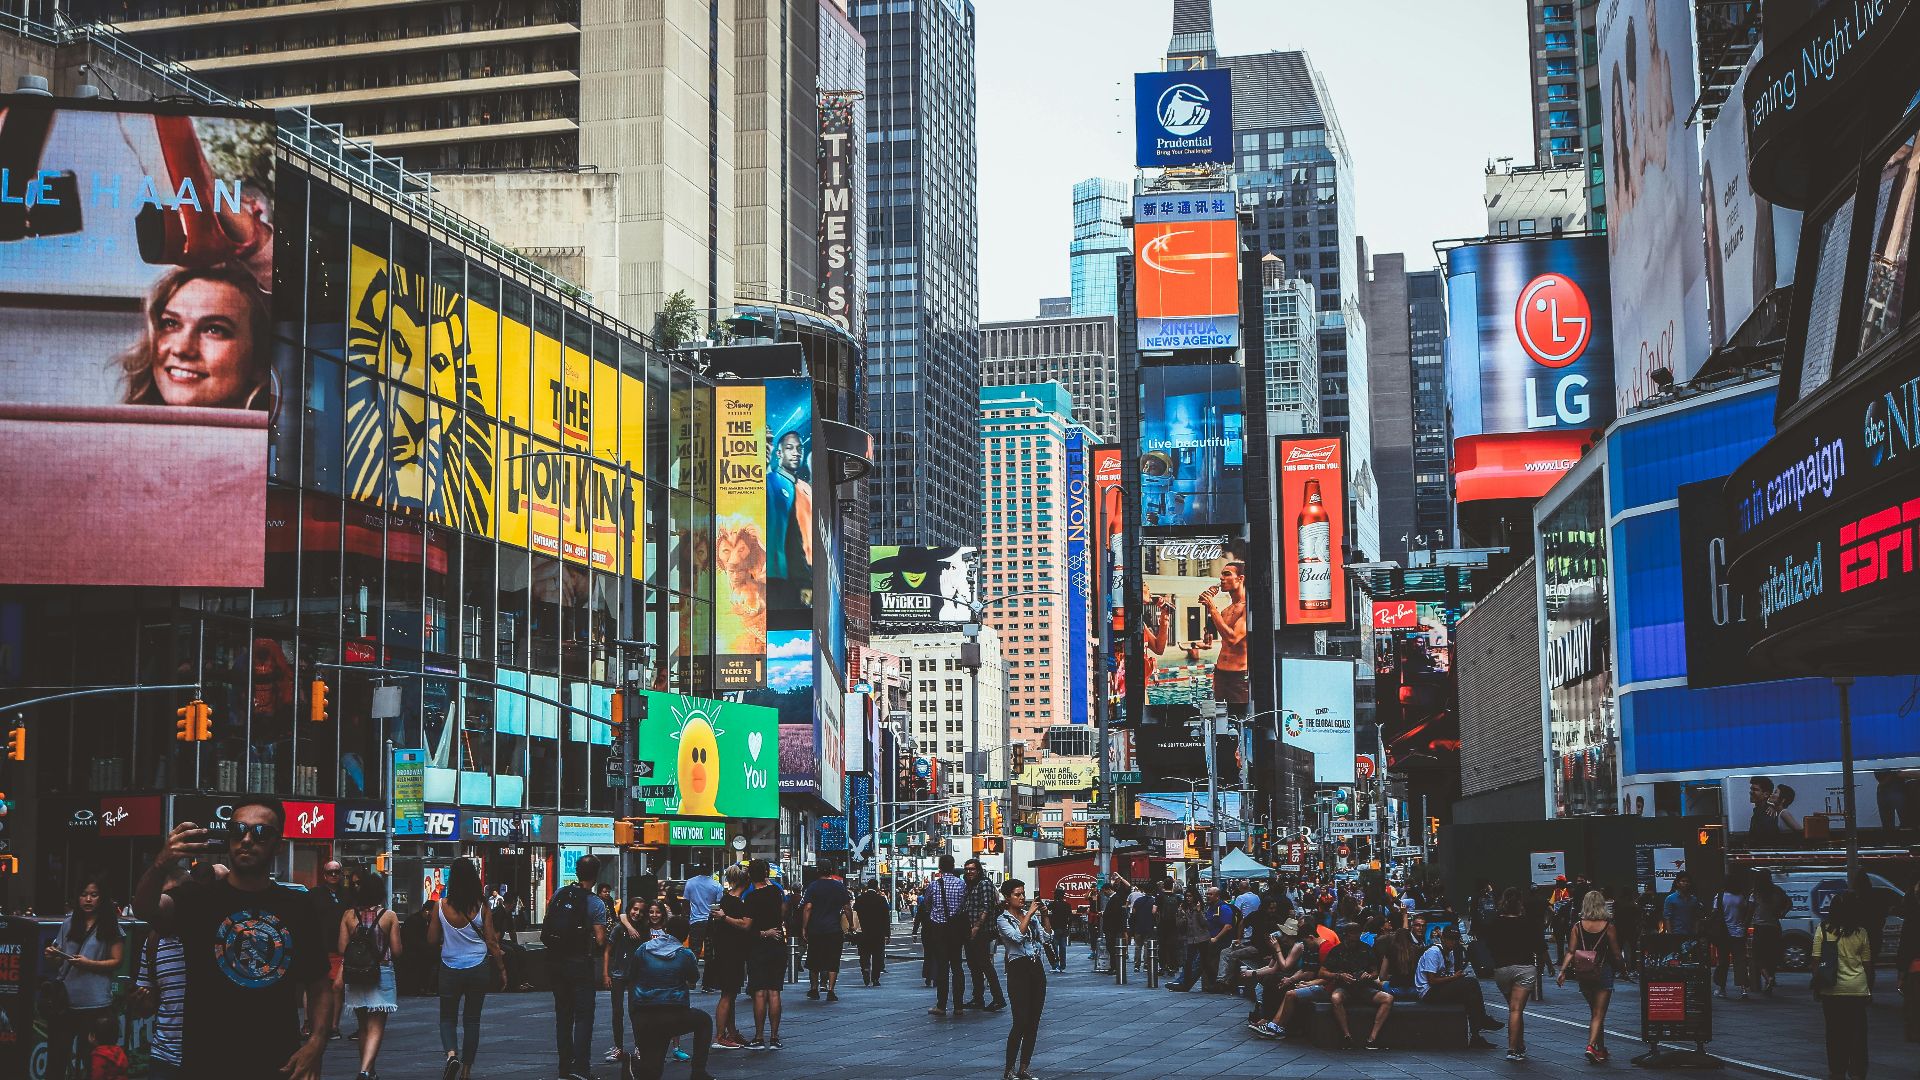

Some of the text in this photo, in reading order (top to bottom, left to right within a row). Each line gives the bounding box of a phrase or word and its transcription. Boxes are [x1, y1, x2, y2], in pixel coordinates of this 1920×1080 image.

[1802, 16, 1852, 87] Night
[1156, 135, 1212, 149] Prudential
[91, 172, 242, 214] HAAN
[823, 132, 849, 269] TIMES
[1143, 199, 1226, 216] 新华通讯社
[1724, 224, 1744, 262] future
[1159, 320, 1218, 336] XINHUA
[1146, 334, 1232, 347] NEWS AGENCY
[549, 378, 590, 433] THE
[724, 399, 754, 410] Disney
[1526, 374, 1591, 429] LG
[727, 420, 752, 433] THE
[1865, 417, 1886, 448] abc
[722, 436, 758, 457] LION
[1148, 437, 1230, 449] Live beautiful
[1291, 449, 1331, 459] Budweiser
[507, 415, 570, 515] LION
[719, 459, 763, 485] KING
[1766, 436, 1845, 516] campaign
[1066, 441, 1085, 542] NOVOTEL
[533, 534, 607, 564] ENTRANCE ON 45TH STREET
[1375, 603, 1414, 624] Ray-Ban
[1547, 617, 1592, 690] OLD NAVY
[1305, 718, 1350, 728] THE GLOBAL GOALS
[743, 761, 767, 790] YOU
[1112, 773, 1119, 782] W
[1121, 773, 1132, 782] 44
[643, 787, 651, 796] W
[654, 787, 664, 796] 44
[102, 806, 129, 827] Ray-Ban
[297, 805, 325, 834] Ray-Ban
[672, 826, 724, 840] NEW YORK LINE
